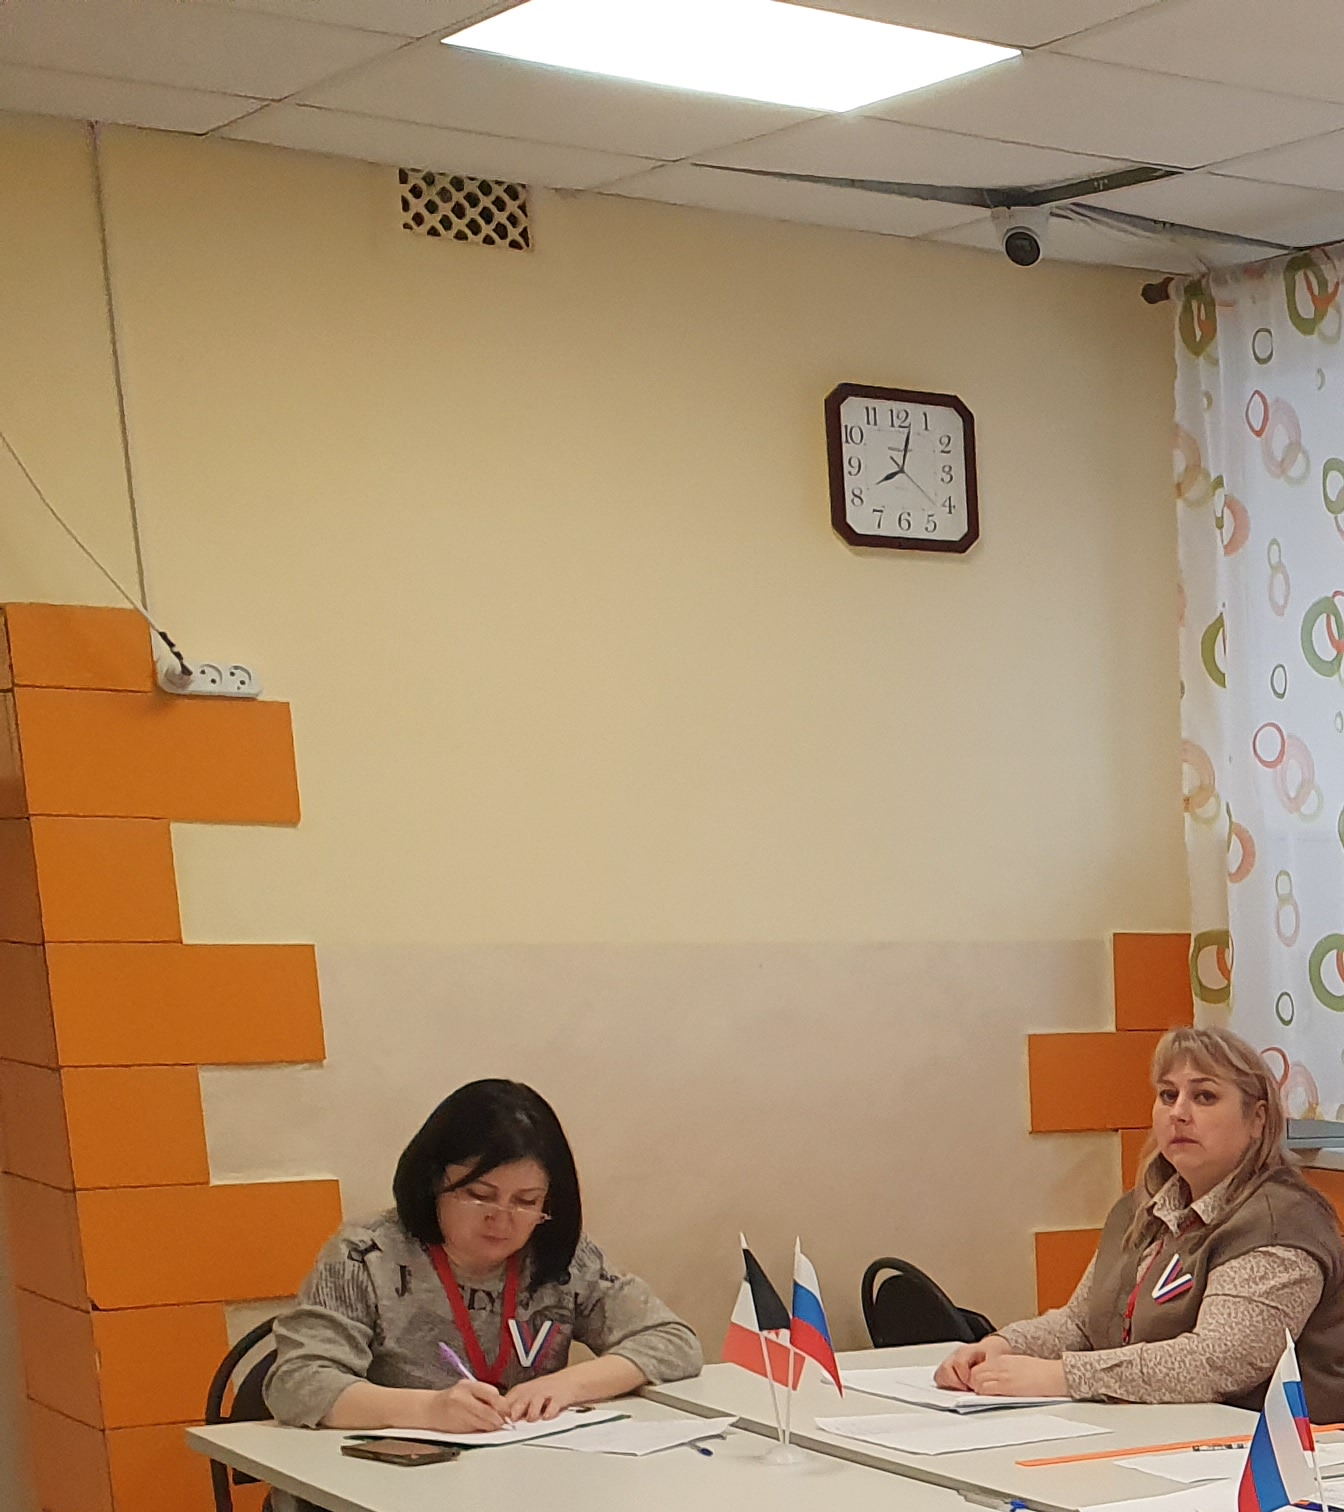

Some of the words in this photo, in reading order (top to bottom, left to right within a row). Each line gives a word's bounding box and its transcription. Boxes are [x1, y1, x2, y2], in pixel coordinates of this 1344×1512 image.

[865, 406, 878, 426] 11
[889, 408, 911, 428] 12
[922, 412, 930, 431] 1
[844, 424, 864, 445] 10
[939, 435, 952, 454] 2
[847, 455, 862, 476] 9
[940, 465, 954, 484] 3
[851, 487, 864, 506] 8
[942, 496, 956, 514] 4
[872, 508, 884, 529] 7
[897, 511, 912, 531] 6
[924, 514, 937, 533] 5
